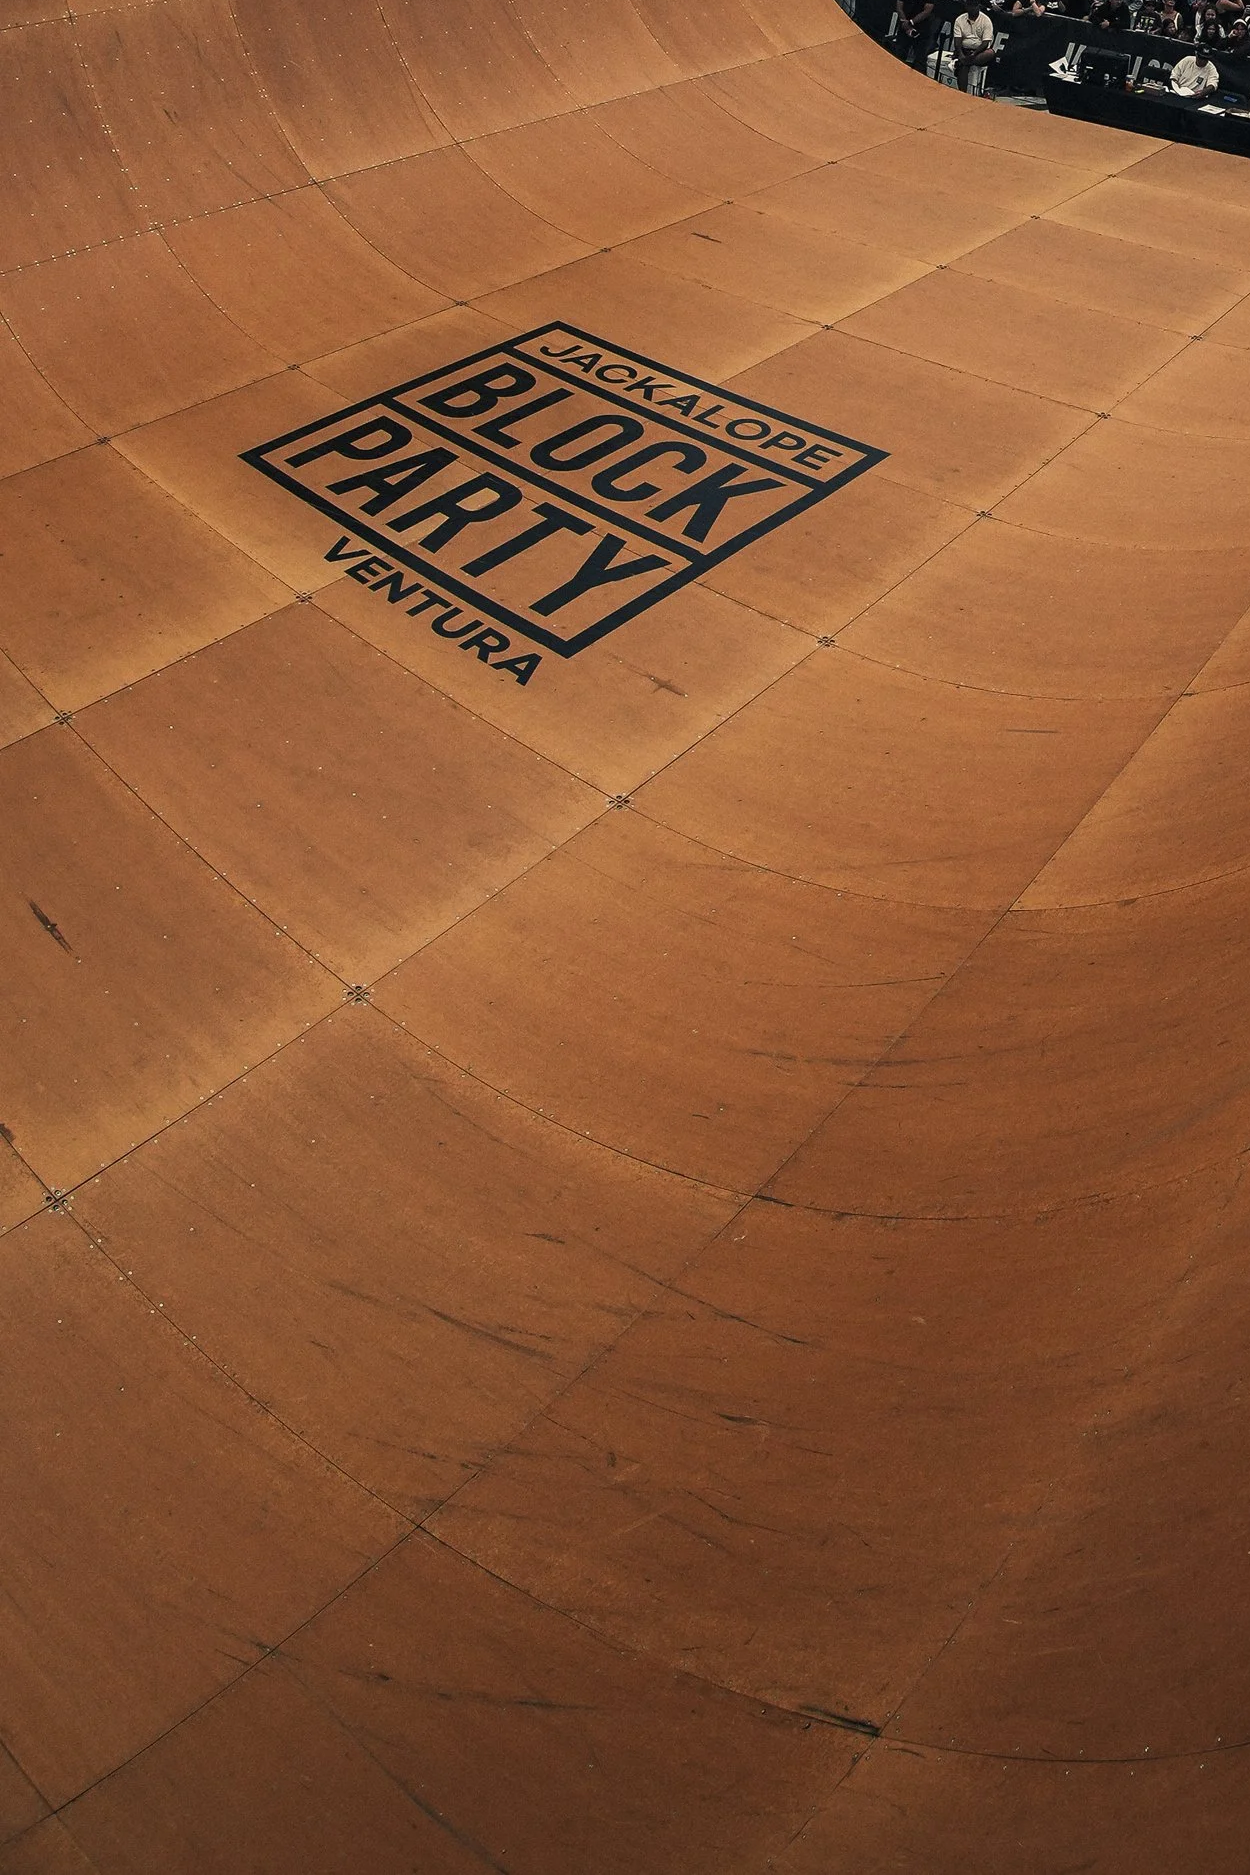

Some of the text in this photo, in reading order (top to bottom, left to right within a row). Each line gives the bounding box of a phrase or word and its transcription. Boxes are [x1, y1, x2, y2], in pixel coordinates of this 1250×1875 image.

[421, 362, 786, 543] BLOCK
[539, 343, 843, 472] JACKALOPE
[285, 415, 672, 617] PARTY
[322, 535, 543, 687] VENTURA
